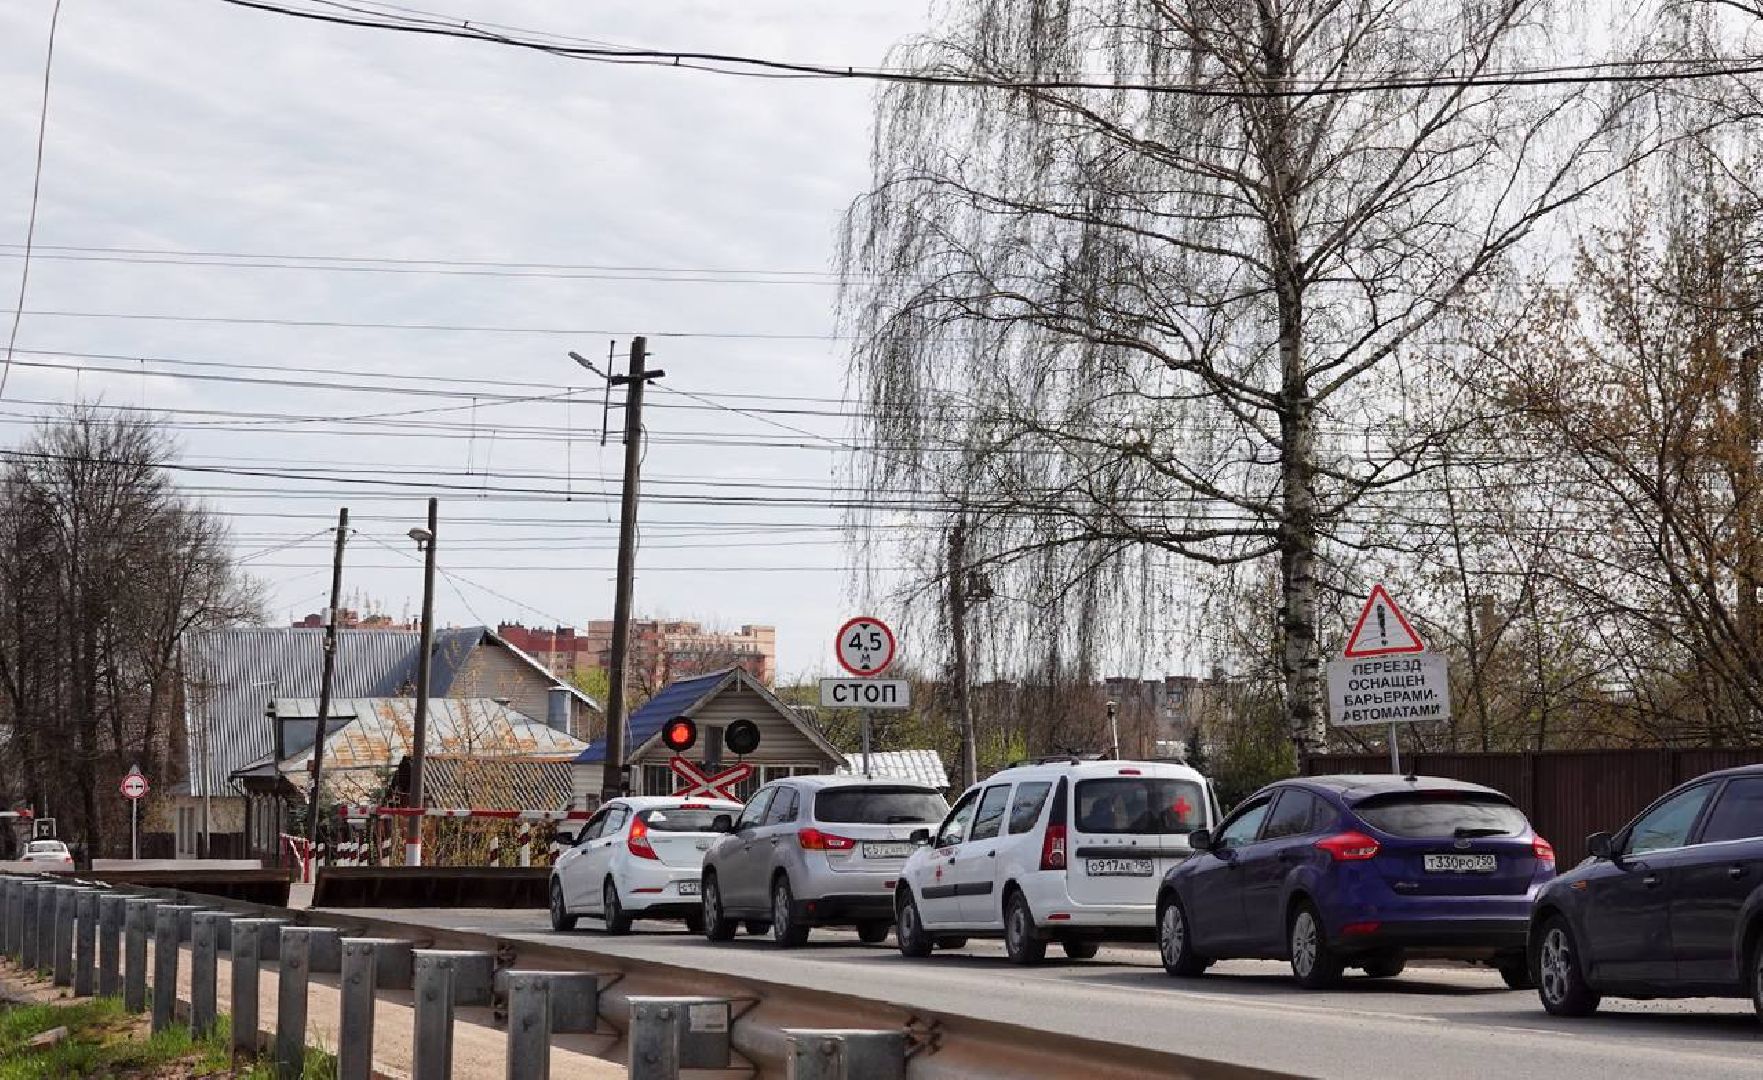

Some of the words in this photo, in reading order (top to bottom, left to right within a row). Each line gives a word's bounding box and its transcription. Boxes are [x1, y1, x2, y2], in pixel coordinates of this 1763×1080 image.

[1352, 659, 1422, 676] ПЕРЕЕЗД
[1348, 675, 1425, 692] ОСНАЩЕН
[832, 683, 897, 703] СТОП
[1342, 704, 1441, 722] АВТОМАТАМИ
